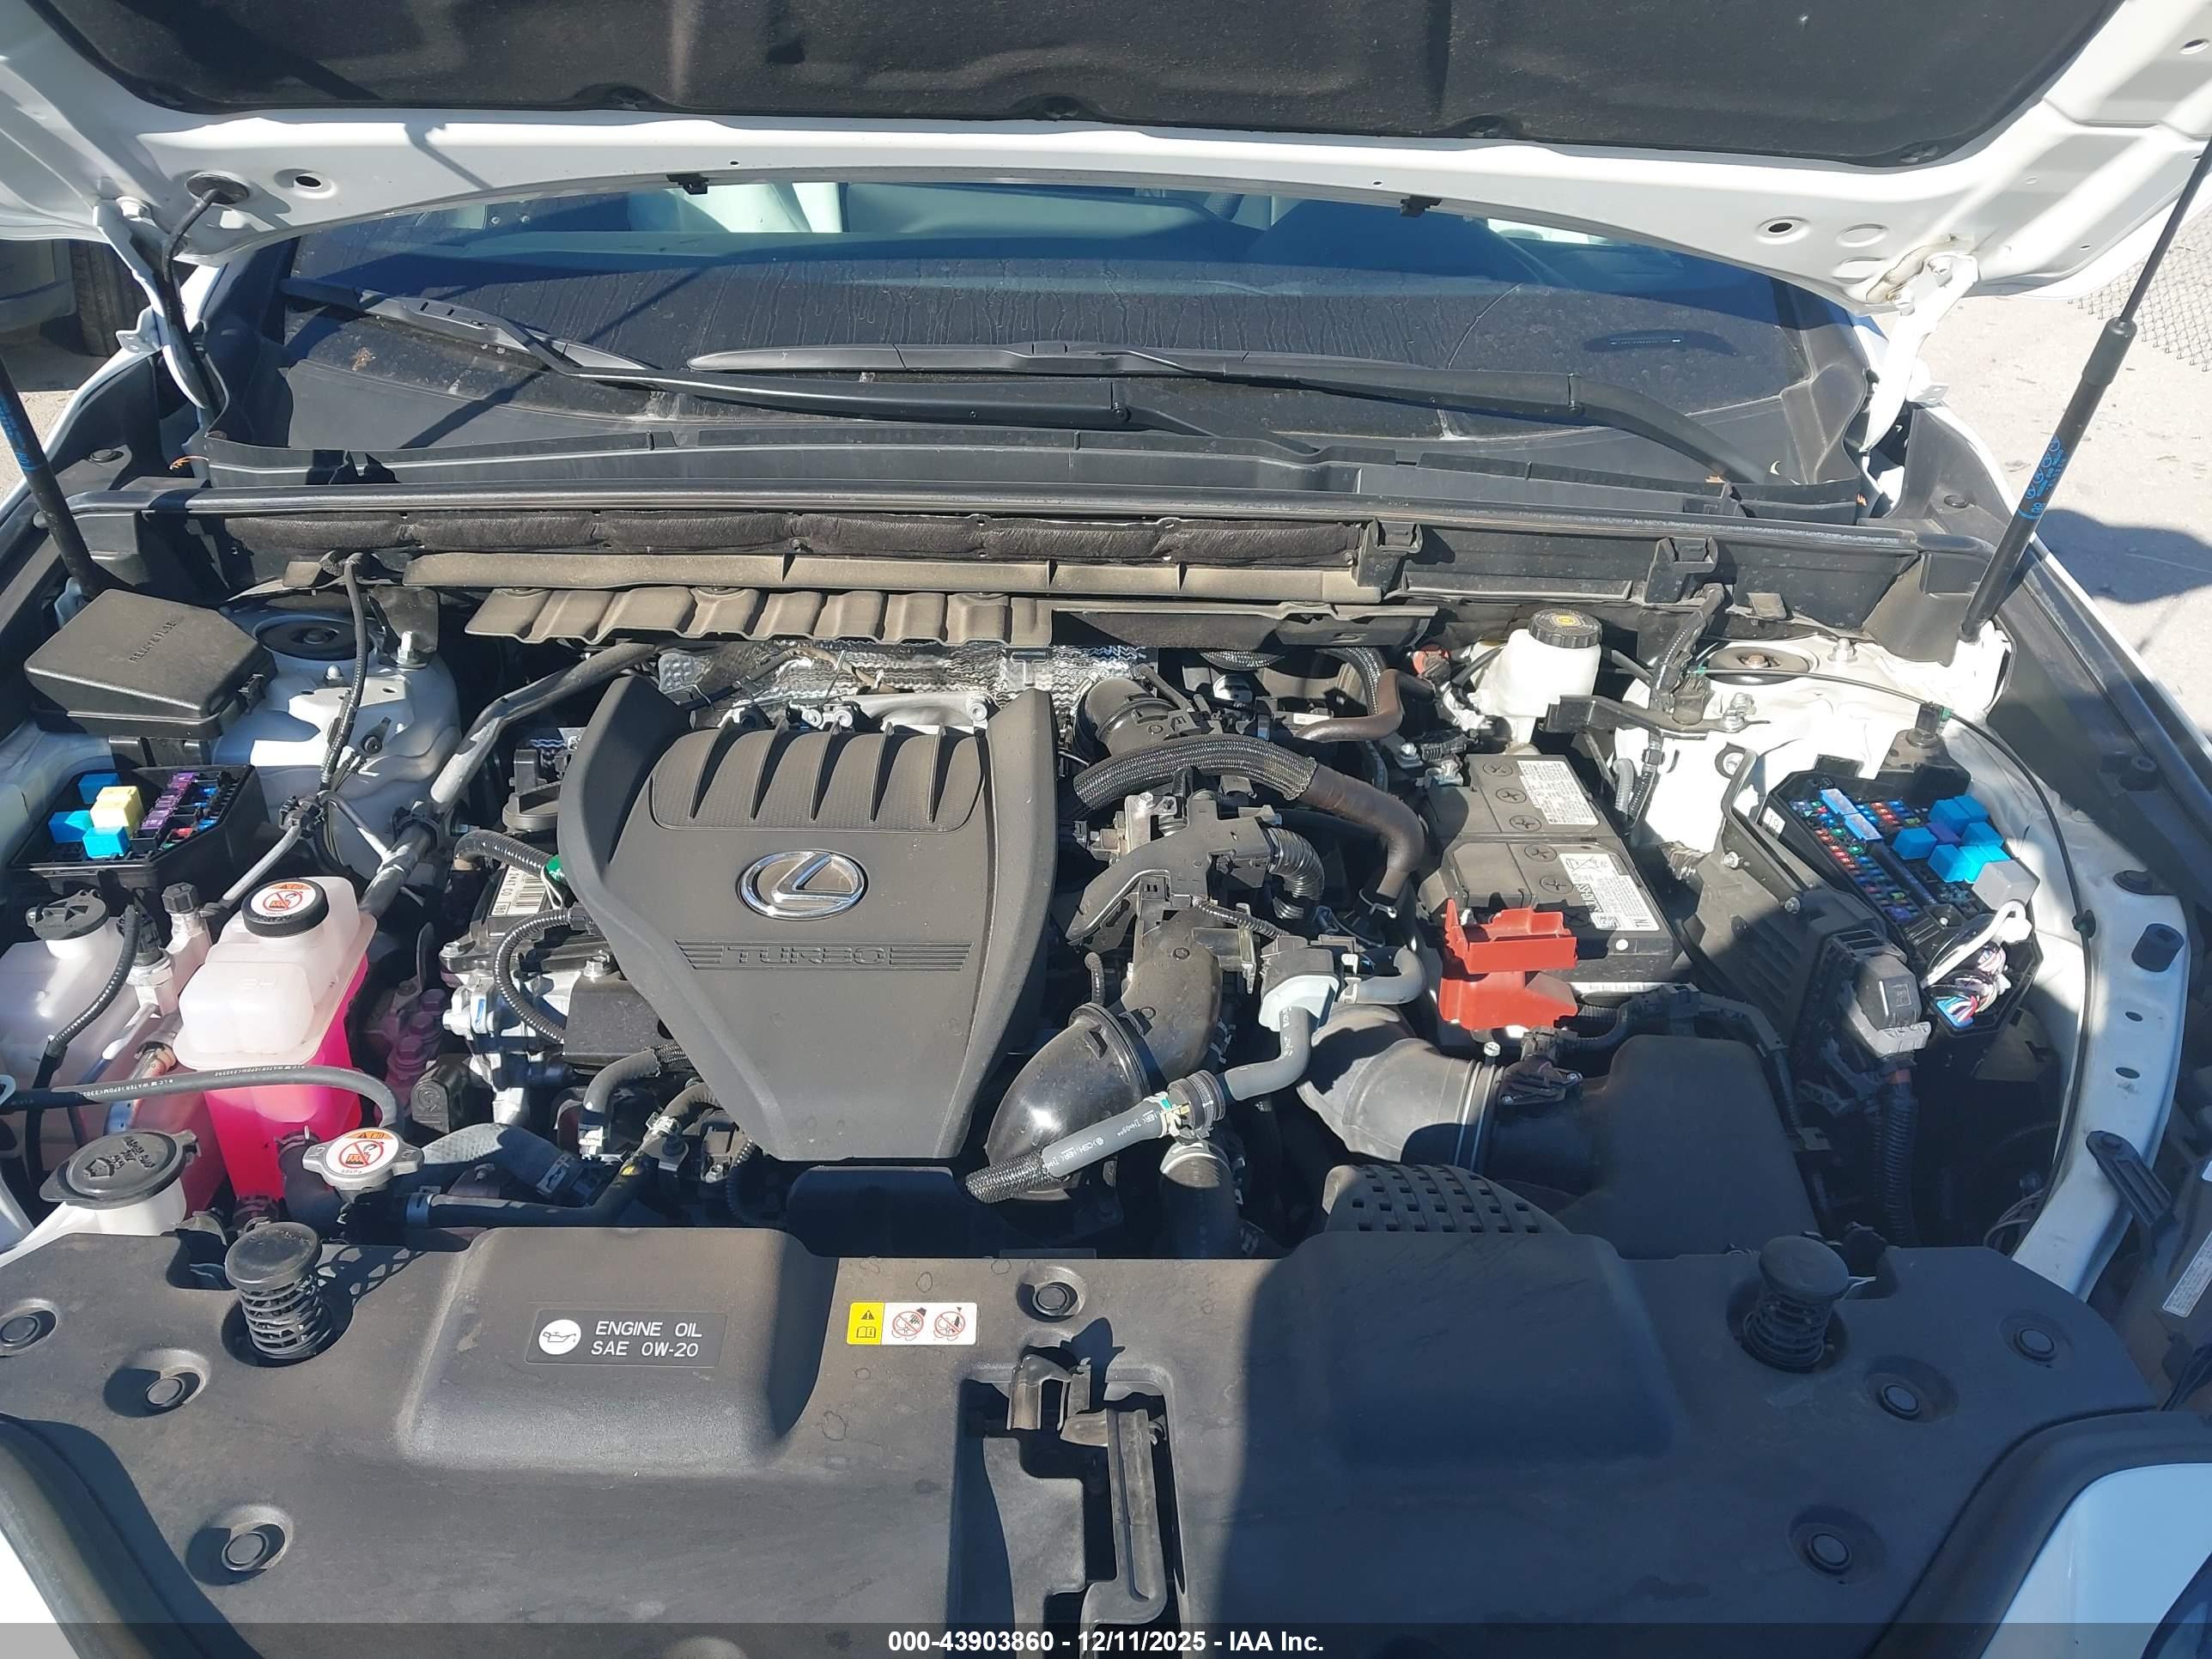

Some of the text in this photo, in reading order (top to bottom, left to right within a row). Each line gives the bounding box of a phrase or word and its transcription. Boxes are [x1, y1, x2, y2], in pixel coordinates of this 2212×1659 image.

[727, 945, 885, 964] TURBO
[595, 1321, 702, 1338] ENGINE OIL
[591, 1340, 699, 1358] SAE 0W-20
